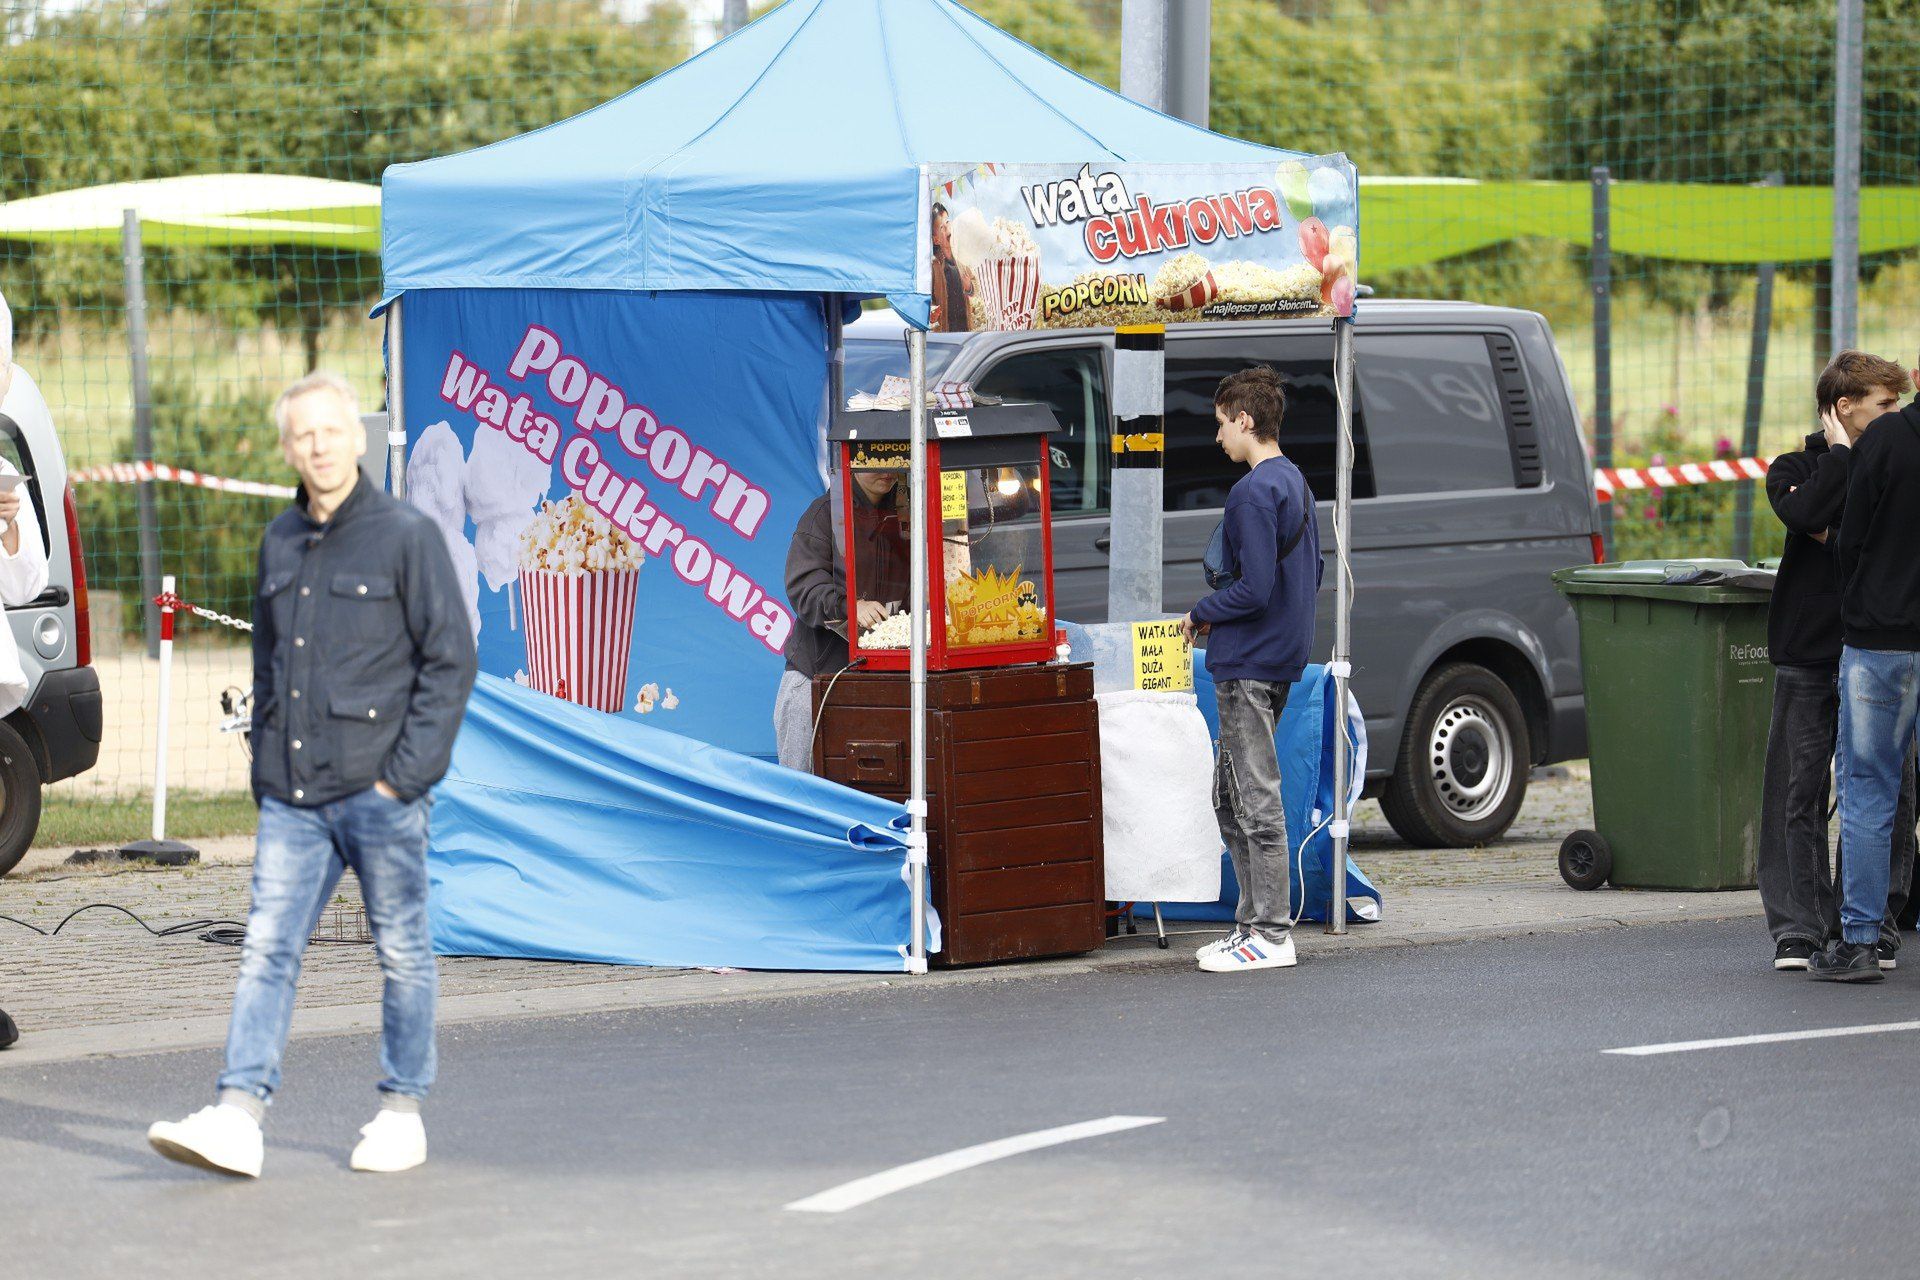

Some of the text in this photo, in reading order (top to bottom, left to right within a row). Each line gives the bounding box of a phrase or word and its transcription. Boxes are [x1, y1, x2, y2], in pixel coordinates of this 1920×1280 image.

[1021, 163, 1131, 227] wata
[1084, 188, 1283, 263] cukrowa
[1043, 274, 1148, 320] POPCORN
[1258, 301, 1277, 314] pod
[1002, 301, 1019, 321] POP
[507, 323, 771, 542] Popcorn
[440, 350, 797, 655] Wata Cukrowa
[960, 590, 1018, 621] POPCORN
[1138, 626, 1166, 639] WATA
[1141, 645, 1163, 657] MAŁA
[1142, 660, 1163, 674] DUŻA
[1142, 677, 1171, 690] GIGANT
